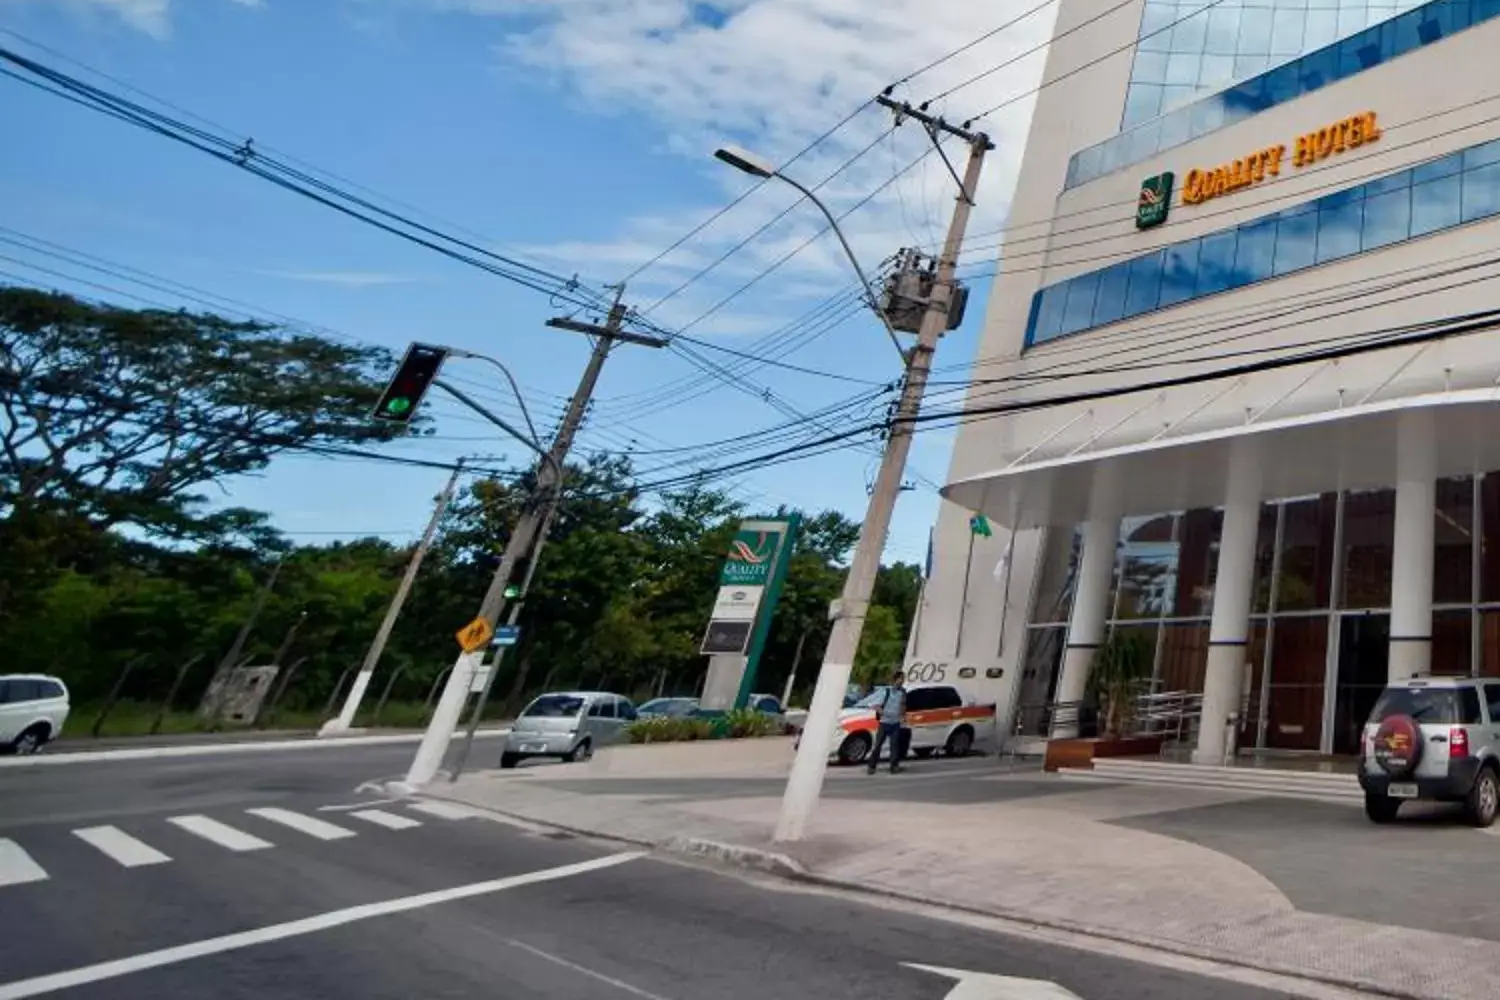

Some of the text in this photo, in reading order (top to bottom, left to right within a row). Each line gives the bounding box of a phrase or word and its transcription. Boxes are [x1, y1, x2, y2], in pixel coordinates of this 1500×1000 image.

[1182, 110, 1382, 205] QUALITY HOTEL
[723, 561, 769, 576] QUALITY
[907, 662, 948, 683] 605
